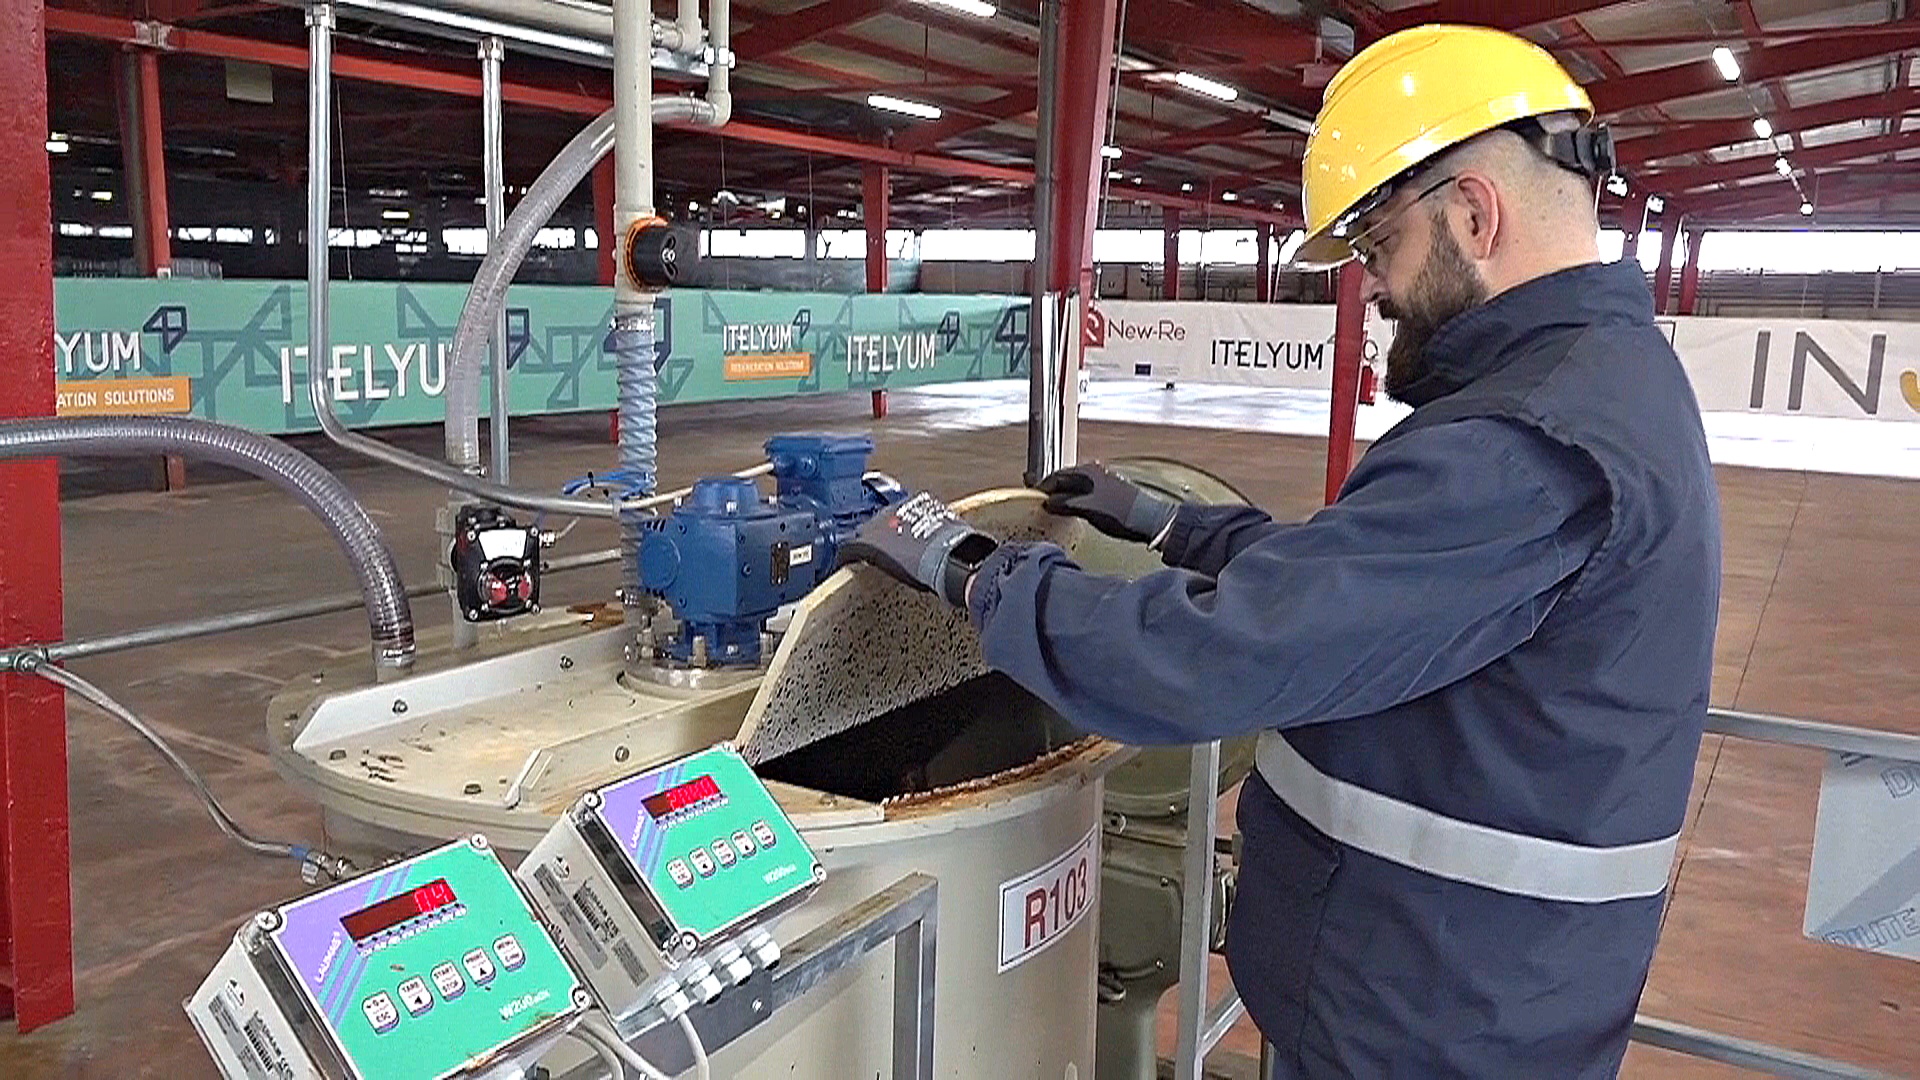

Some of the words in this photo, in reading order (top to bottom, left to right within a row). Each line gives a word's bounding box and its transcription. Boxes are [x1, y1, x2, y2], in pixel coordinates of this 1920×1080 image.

[723, 324, 792, 351] ITELYUM
[1108, 319, 1185, 341] New-Re
[54, 332, 141, 374] YUM
[281, 343, 453, 404] IELYU
[847, 333, 935, 374] ITELYUM
[1211, 339, 1324, 370] ITELYUM
[1750, 331, 1920, 415] IN
[104, 388, 175, 405] SOLUTIONS
[1024, 857, 1087, 949] R103
